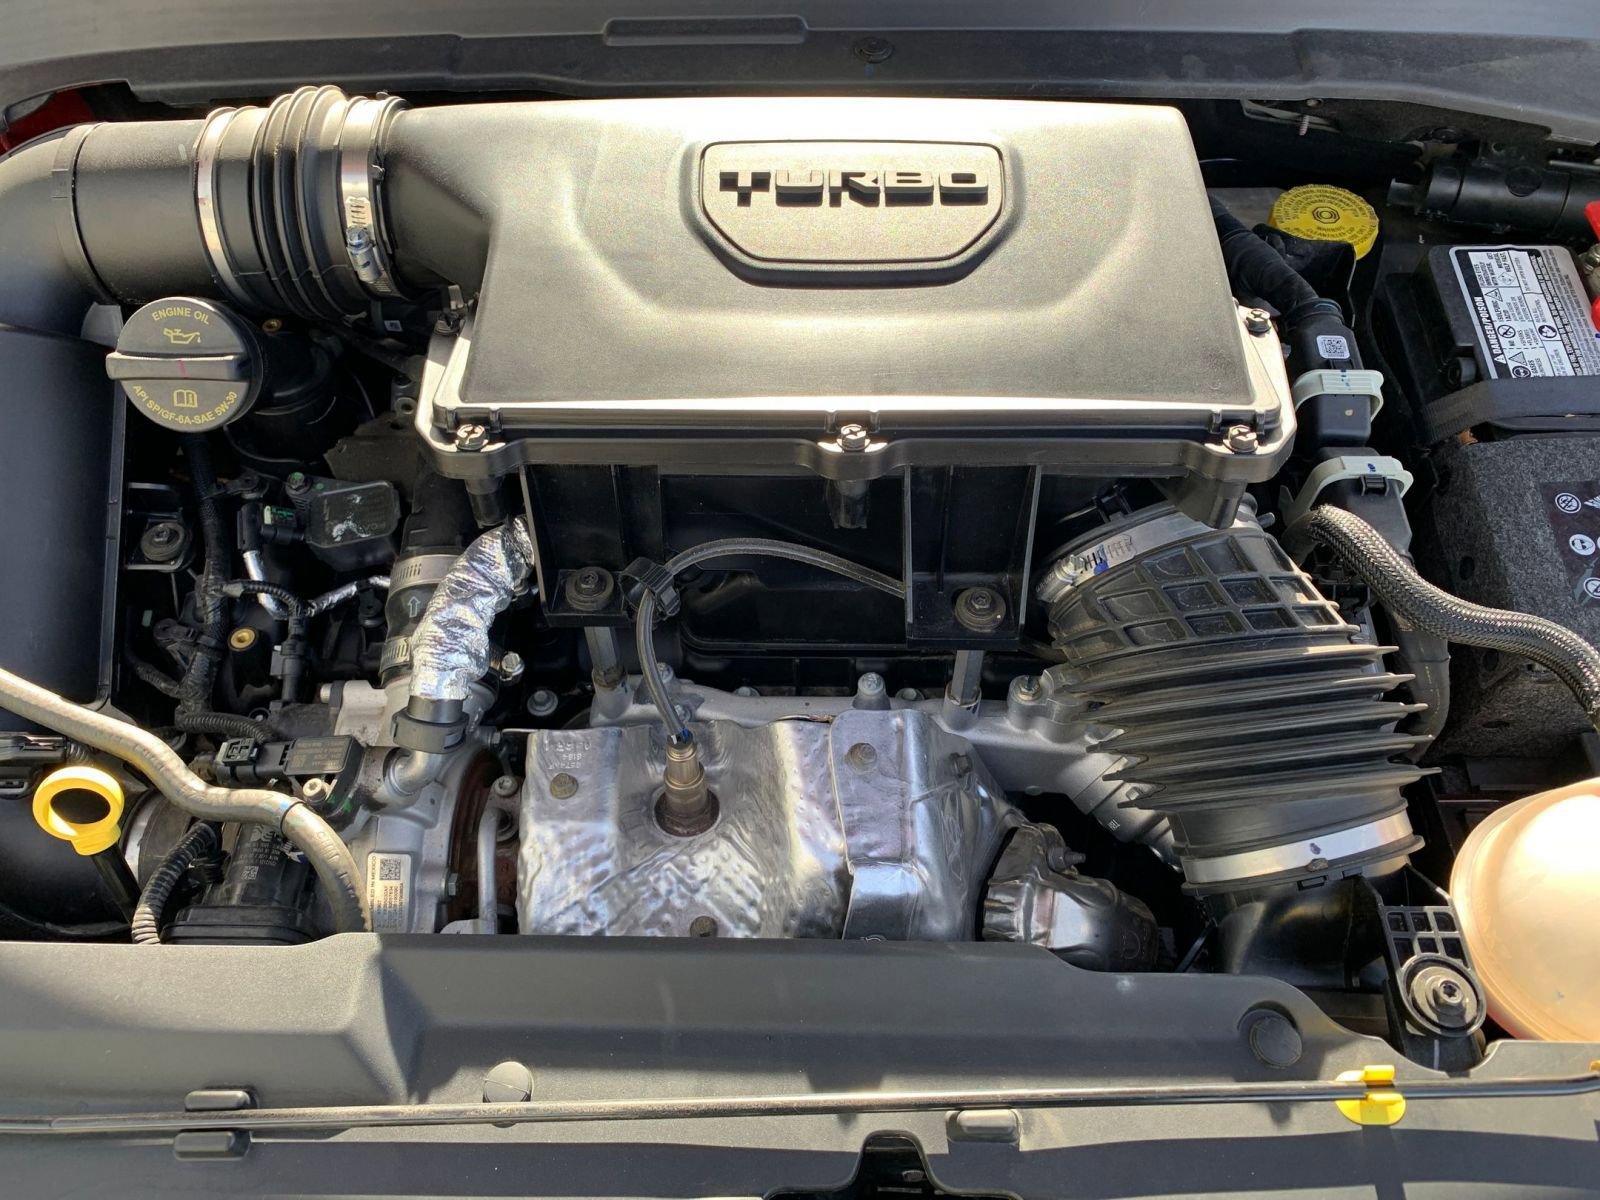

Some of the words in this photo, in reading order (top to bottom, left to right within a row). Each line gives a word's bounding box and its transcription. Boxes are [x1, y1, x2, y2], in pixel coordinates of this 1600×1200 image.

[719, 168, 989, 206] TURBO
[1503, 262, 1511, 271] HELP
[151, 307, 191, 321] ENGINE
[194, 310, 210, 325] OIL
[1473, 296, 1502, 353] DANGER/POISON
[1527, 359, 1538, 373] GASES
[132, 384, 149, 402] API
[146, 399, 216, 425] SP/GF-6A-SAE
[215, 391, 238, 416] 5W-30
